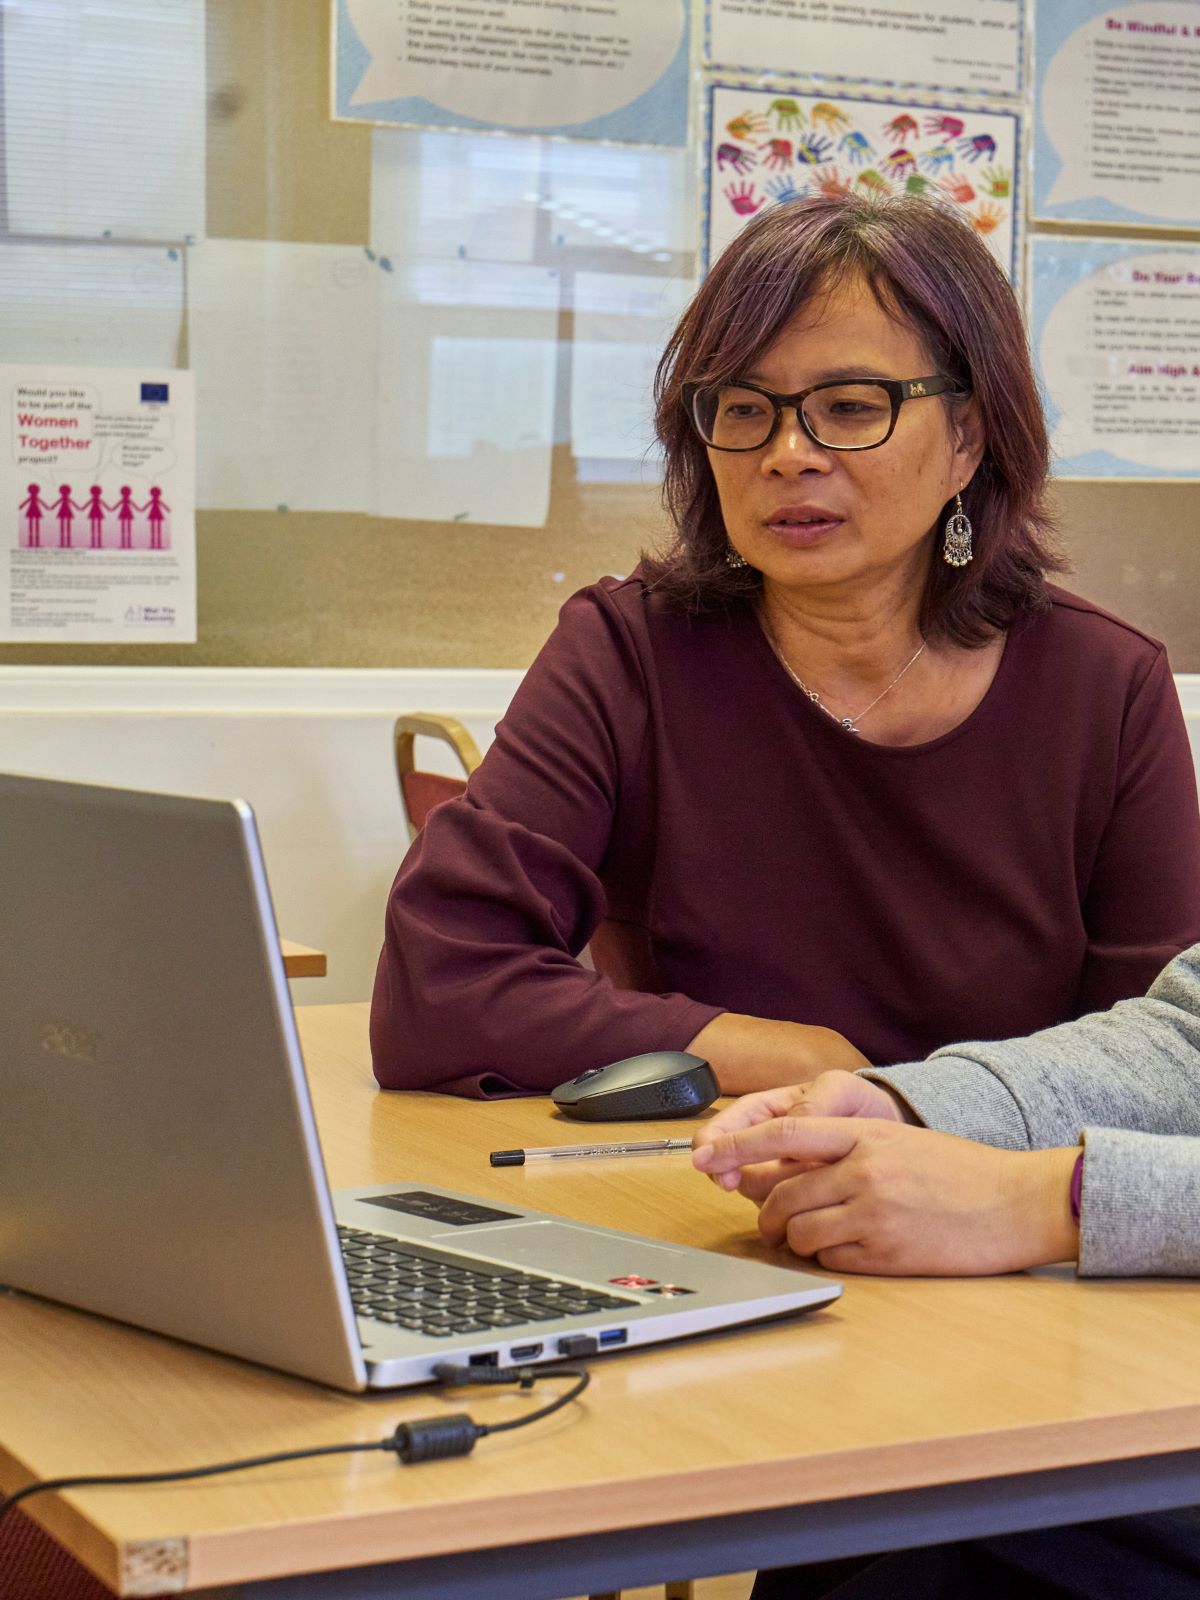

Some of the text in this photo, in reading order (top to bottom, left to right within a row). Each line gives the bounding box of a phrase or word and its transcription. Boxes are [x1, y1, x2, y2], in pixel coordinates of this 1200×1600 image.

[1106, 18, 1122, 31] Be
[1127, 20, 1176, 34] Mindful
[1132, 271, 1149, 282] Do
[1154, 272, 1182, 284] Your
[1157, 365, 1187, 378] High
[18, 386, 85, 399] Would you like
[17, 400, 91, 411] to be part of the
[18, 413, 78, 428] Women
[18, 434, 91, 452] Together
[18, 454, 58, 465] project?
